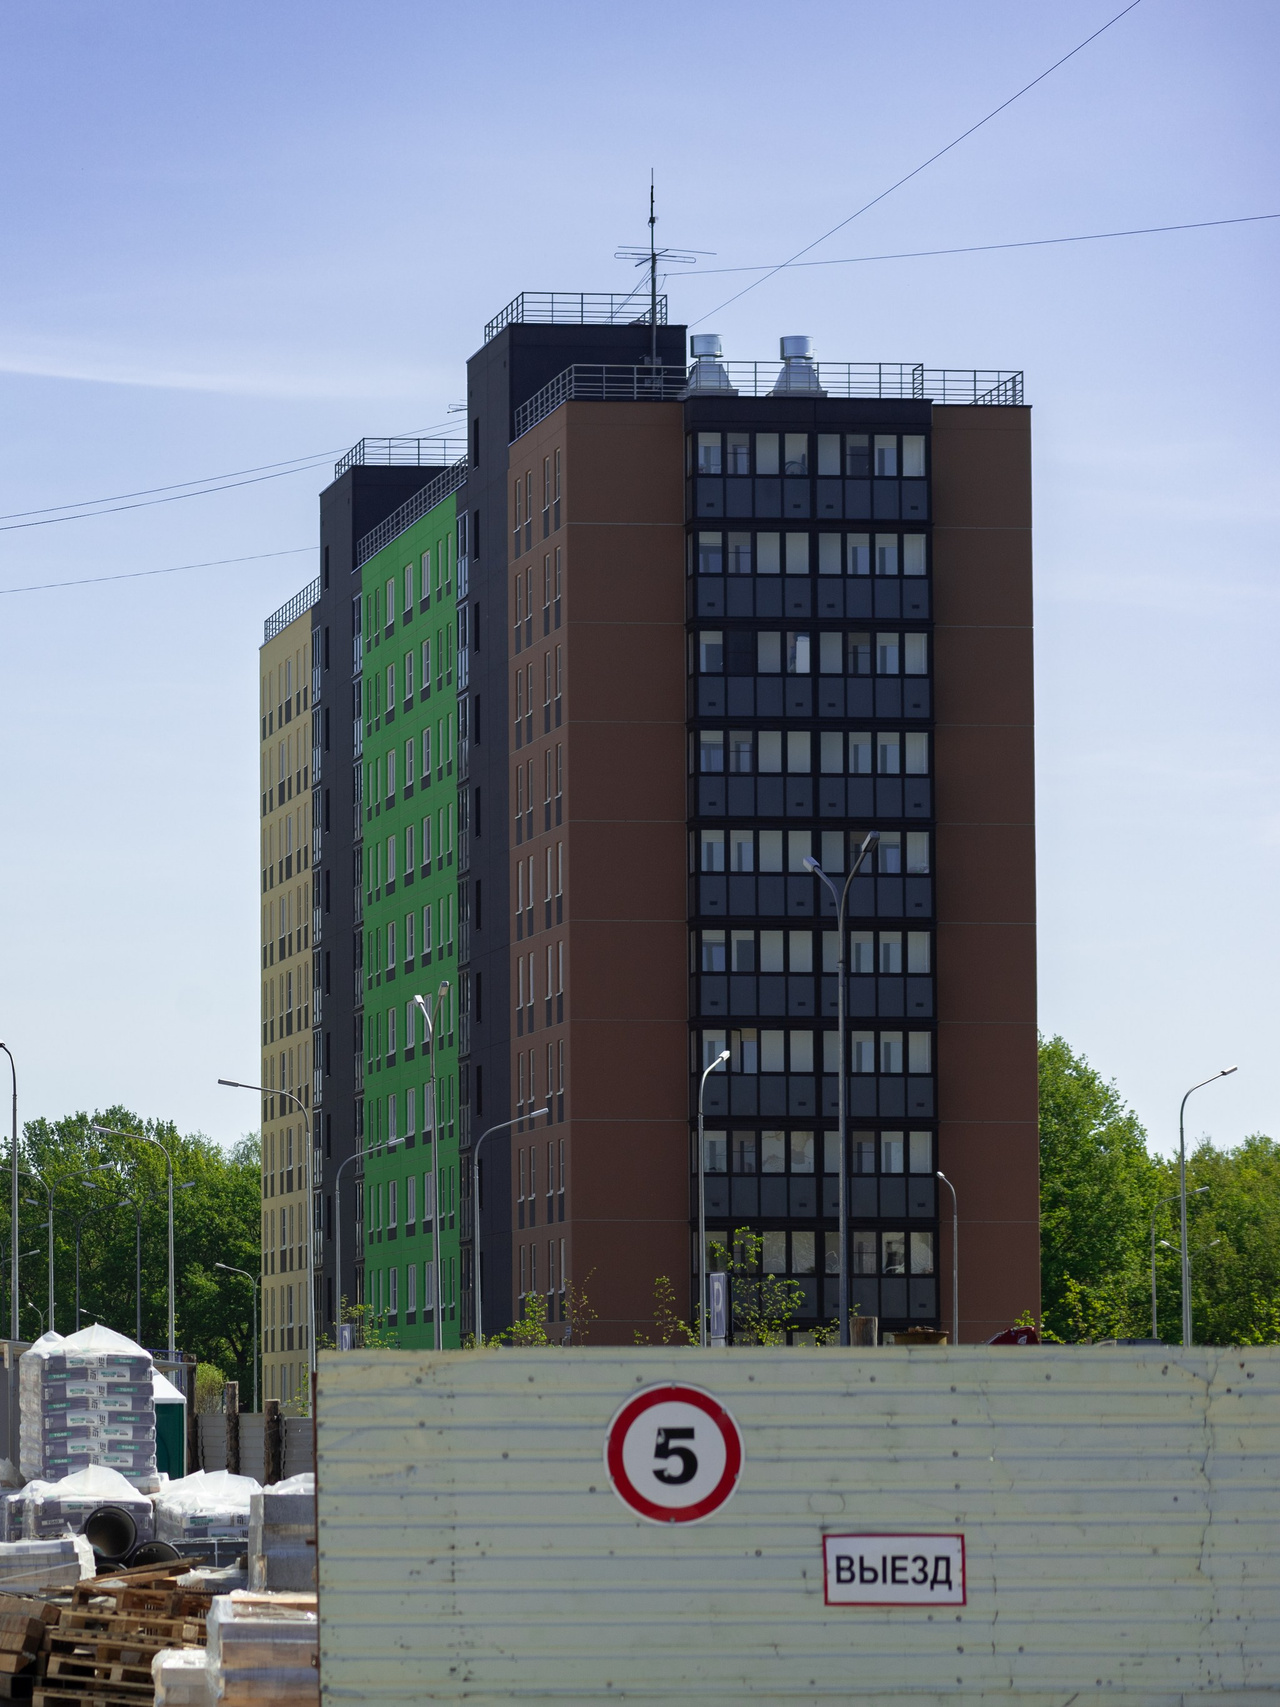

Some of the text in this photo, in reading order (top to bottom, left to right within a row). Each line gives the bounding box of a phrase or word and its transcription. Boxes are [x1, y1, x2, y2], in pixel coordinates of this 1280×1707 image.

[713, 1281, 722, 1330] P
[652, 1426, 698, 1485] 5
[835, 1554, 952, 1592] ВЫЕЗД
